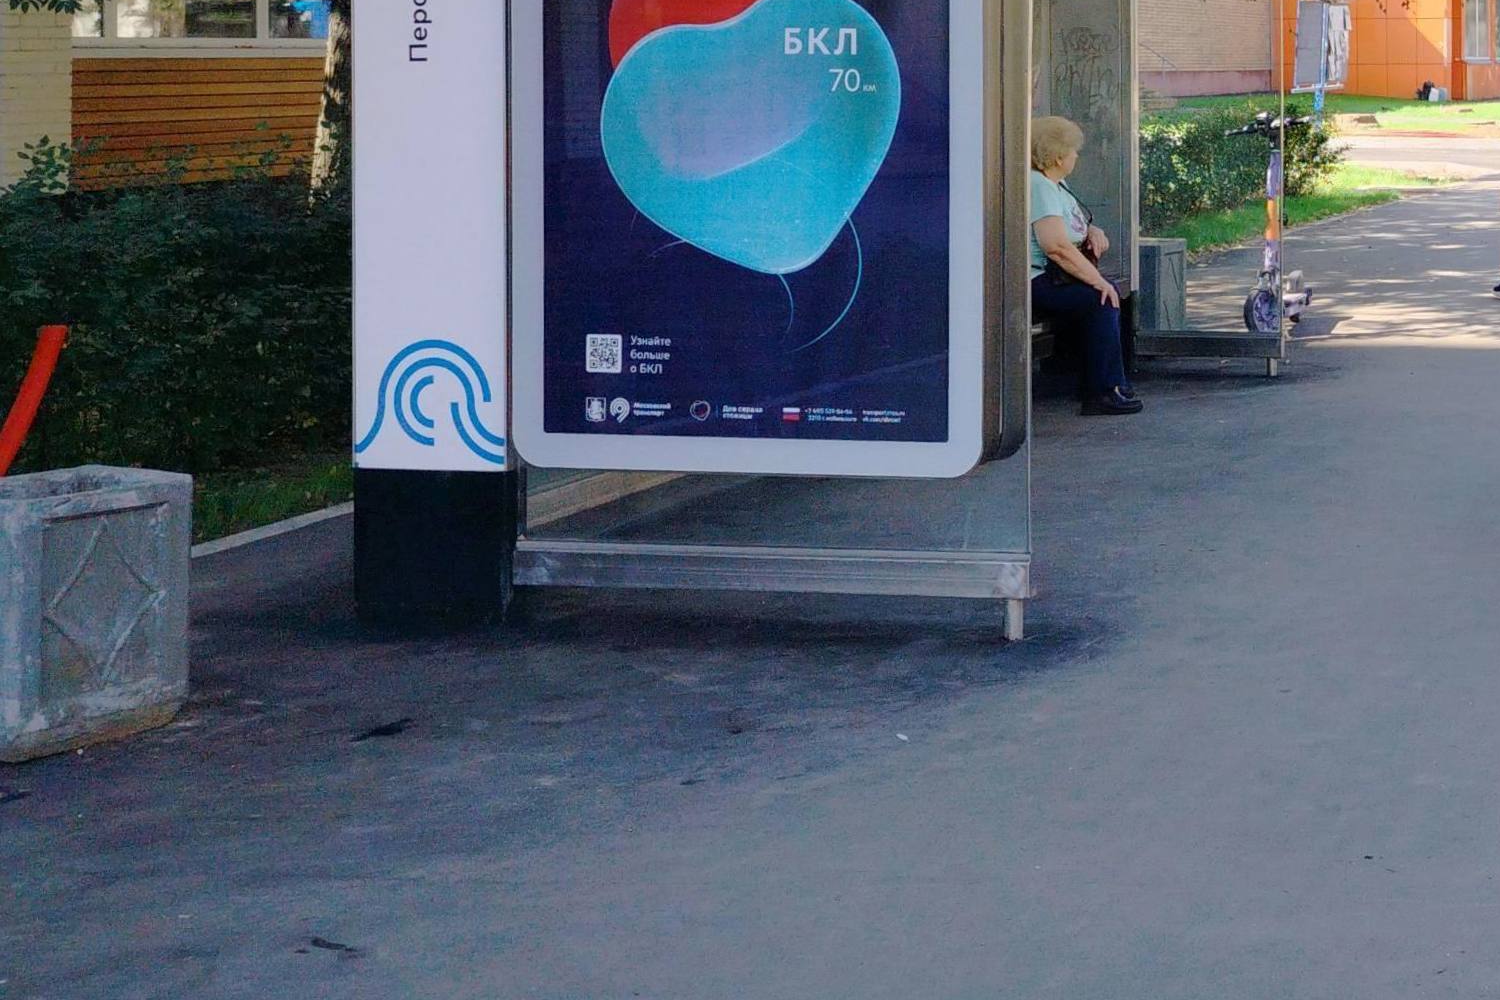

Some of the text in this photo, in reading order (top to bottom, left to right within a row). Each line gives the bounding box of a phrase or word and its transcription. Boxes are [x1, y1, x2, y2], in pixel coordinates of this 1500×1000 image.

[784, 27, 857, 56] БКЛ
[828, 68, 861, 93] 70
[630, 335, 672, 347] Узнайте
[629, 348, 671, 360] больше
[629, 362, 663, 375] о БКЛ
